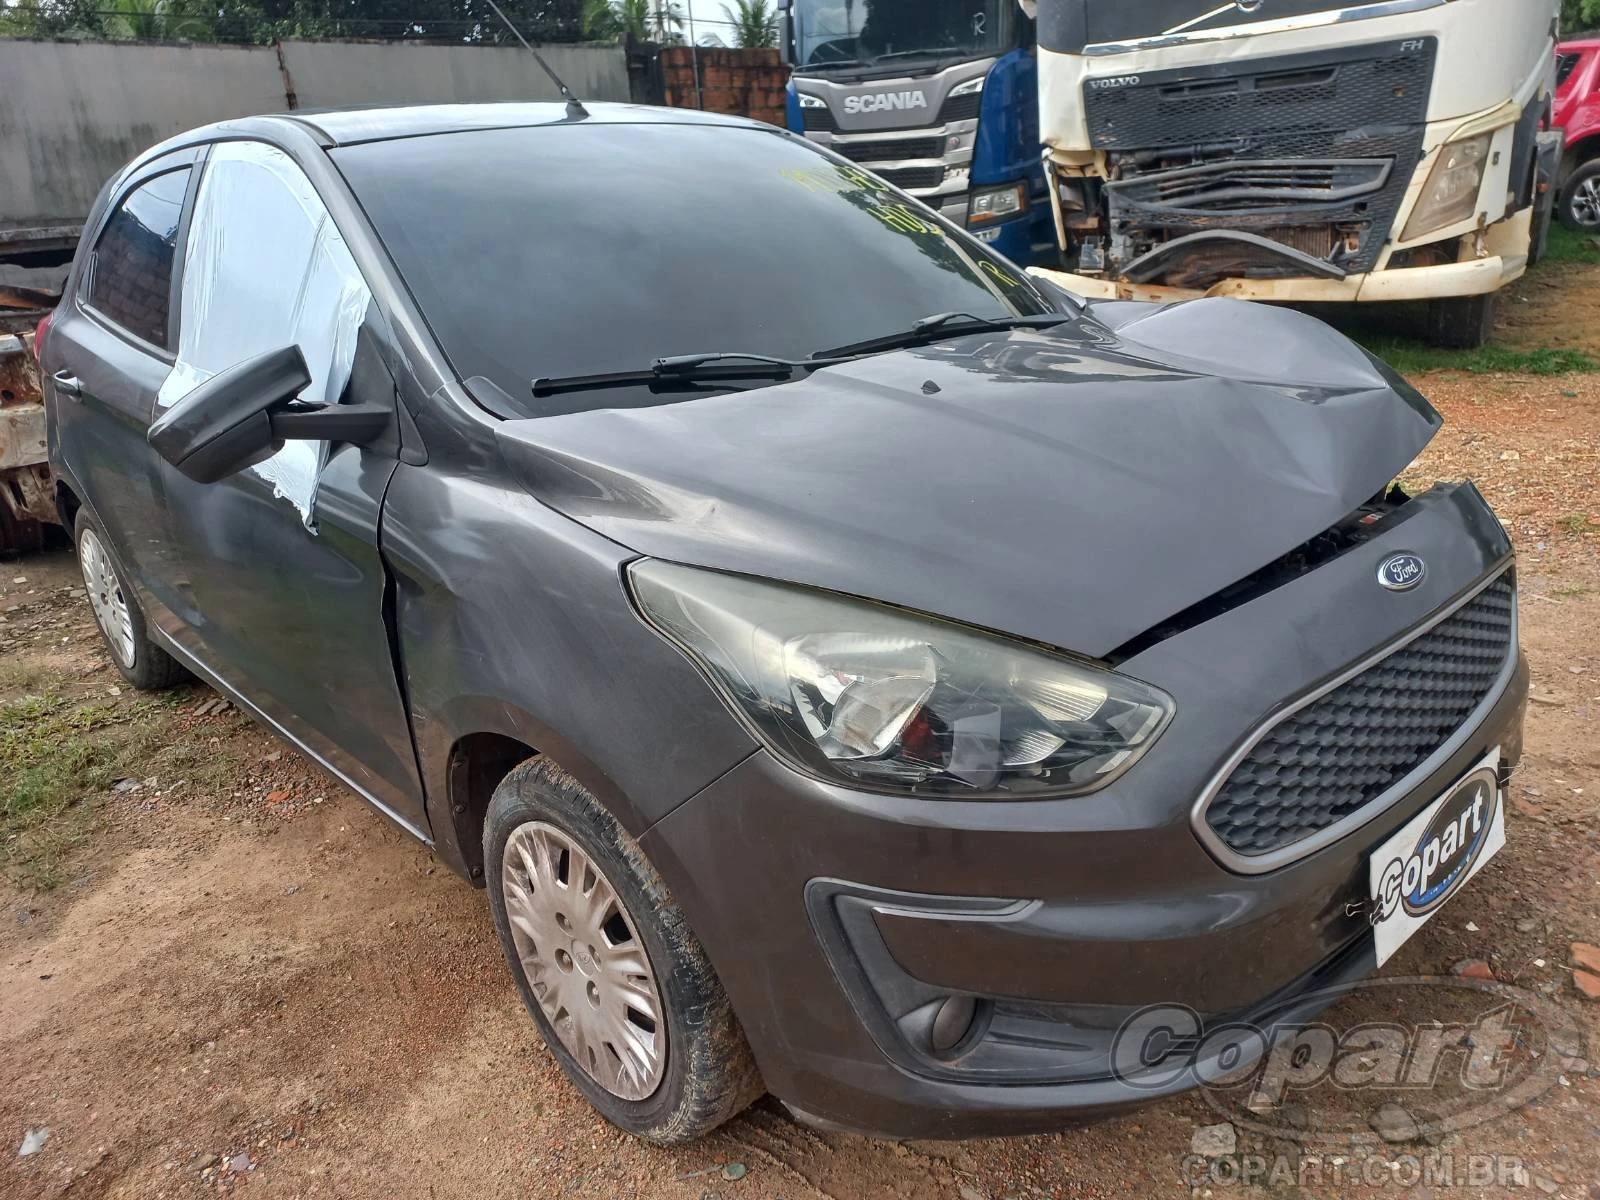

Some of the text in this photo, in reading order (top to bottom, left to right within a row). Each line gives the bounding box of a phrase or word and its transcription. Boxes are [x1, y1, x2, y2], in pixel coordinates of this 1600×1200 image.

[1400, 39, 1425, 52] FH
[1090, 75, 1140, 90] VOLVO
[843, 90, 928, 115] SCANIA
[1390, 558, 1419, 582] Ford
[1378, 785, 1483, 921] Copart
